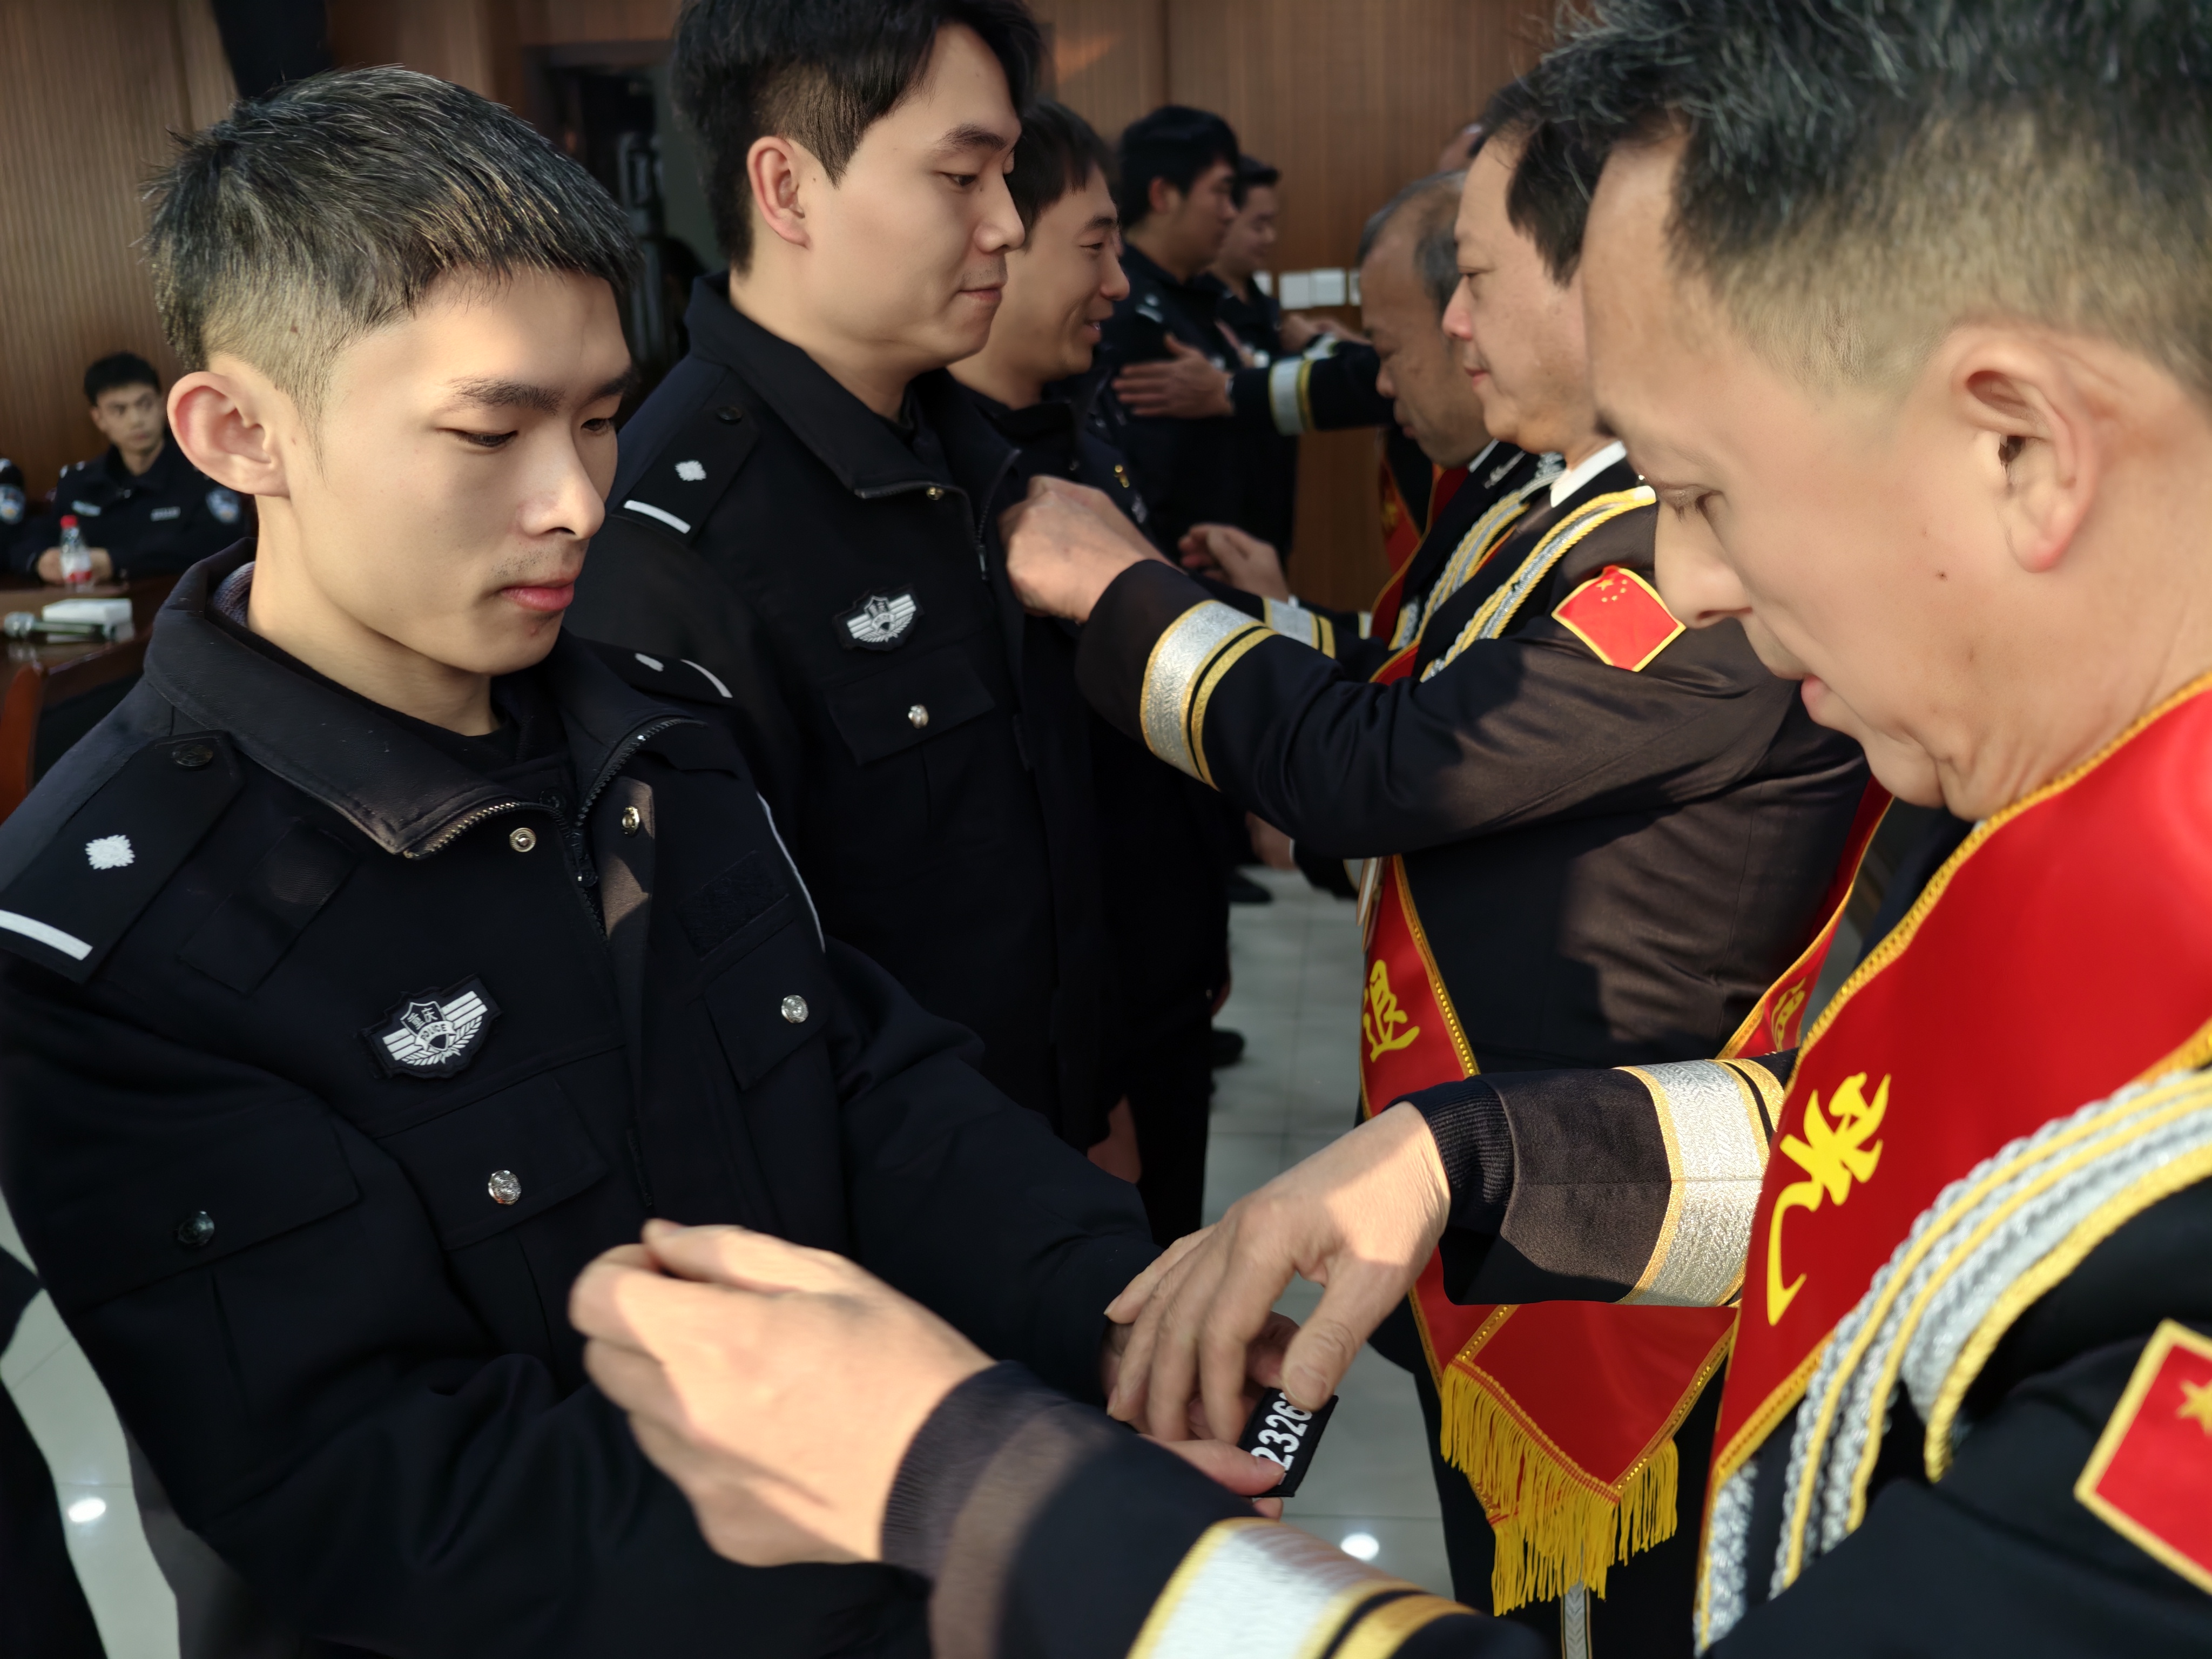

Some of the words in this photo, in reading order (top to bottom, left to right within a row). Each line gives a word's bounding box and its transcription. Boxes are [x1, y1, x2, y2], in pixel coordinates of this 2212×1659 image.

[407, 1007, 438, 1030] 重庆
[420, 1023, 449, 1042] POLICE
[1250, 1391, 1313, 1485] 2326
